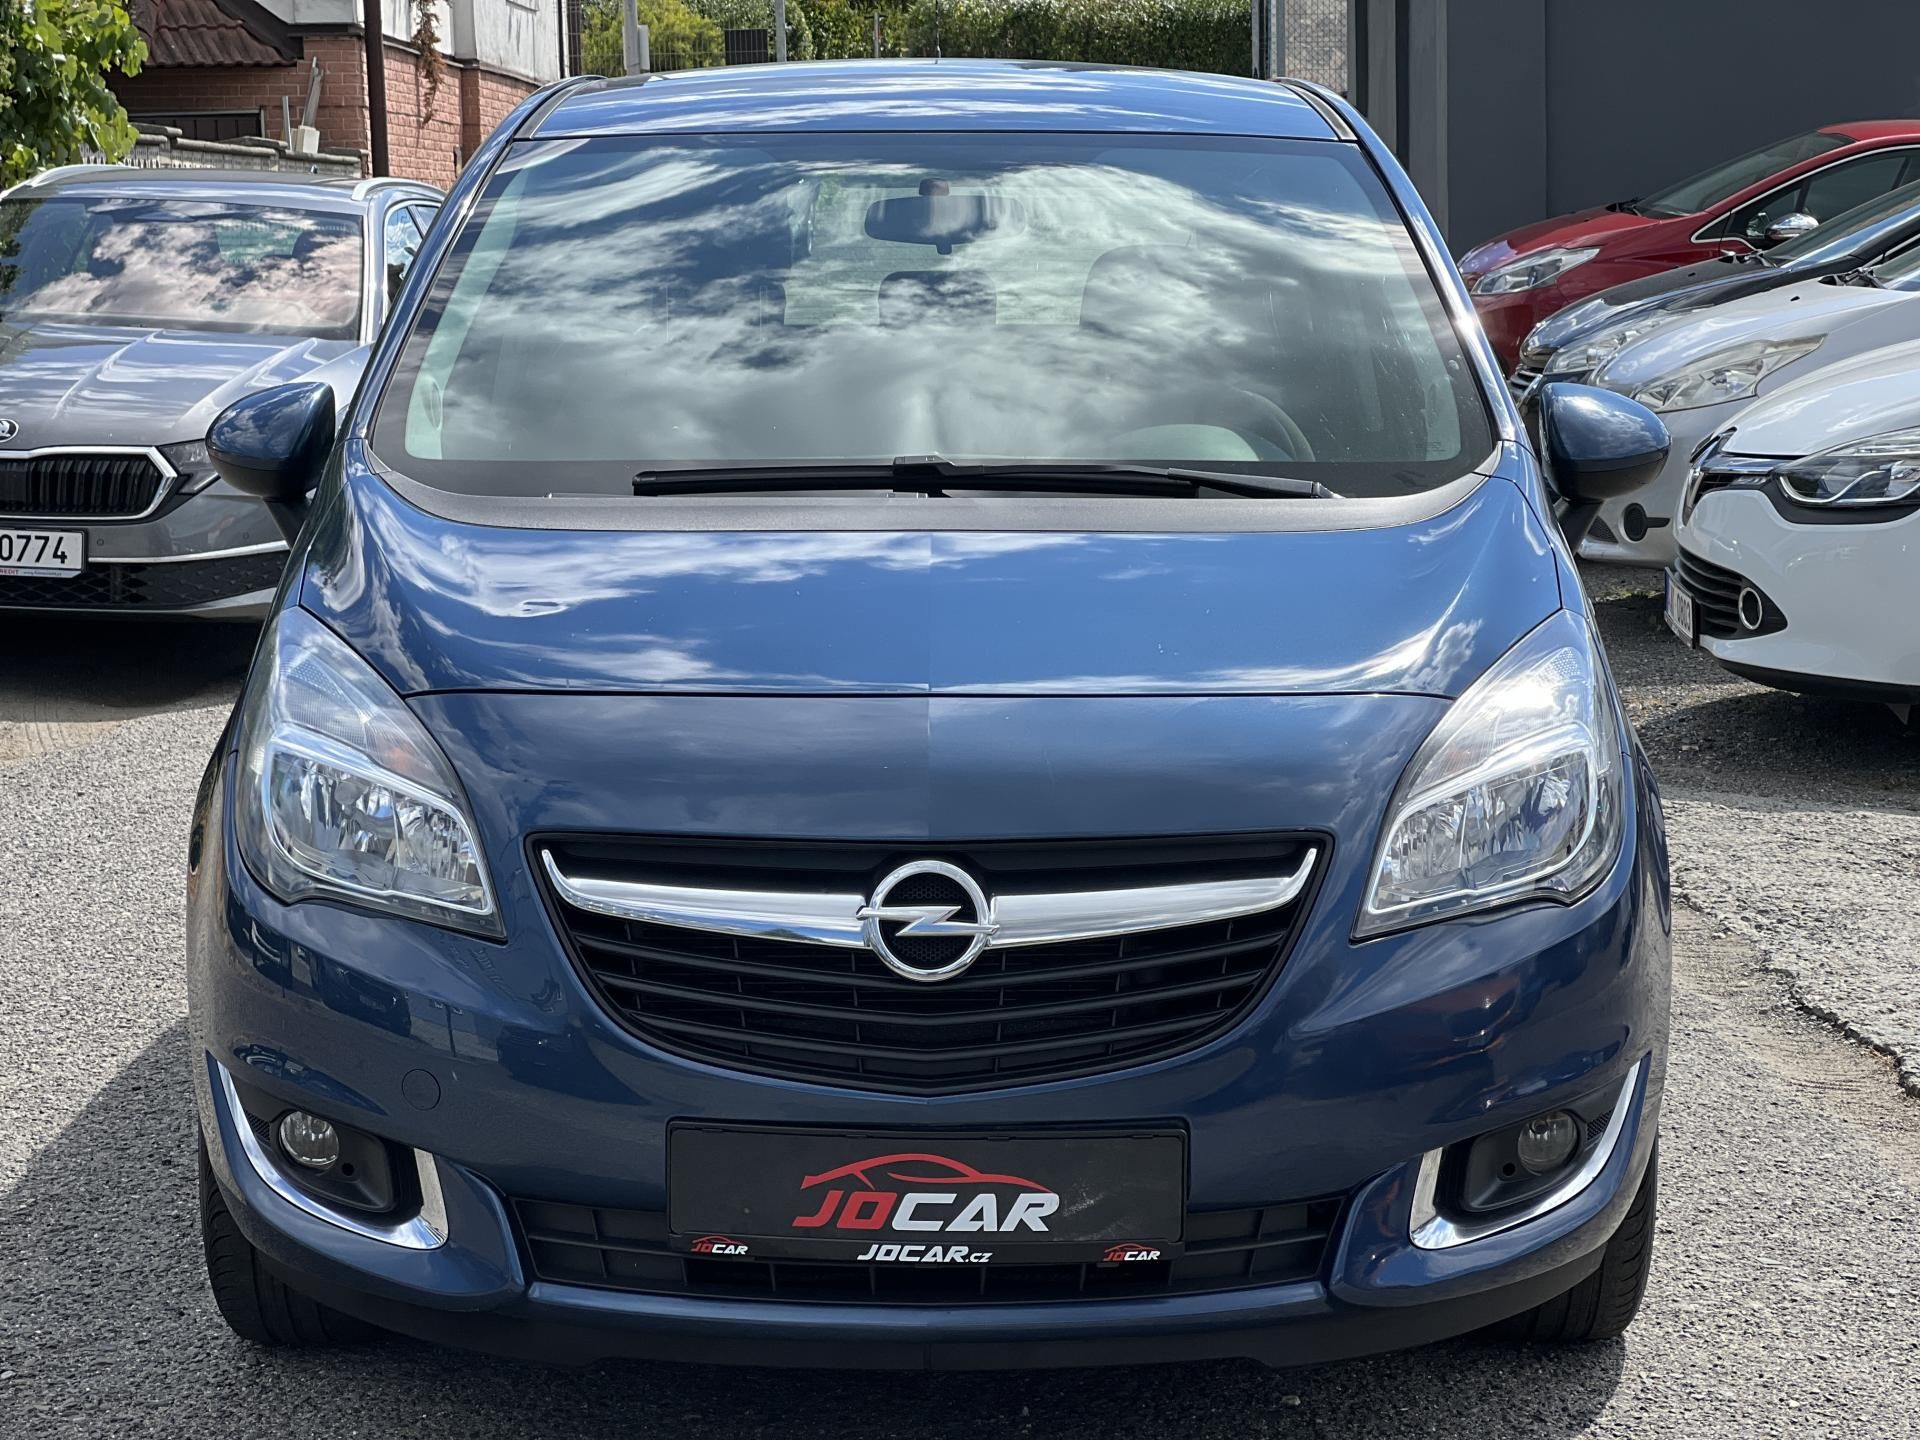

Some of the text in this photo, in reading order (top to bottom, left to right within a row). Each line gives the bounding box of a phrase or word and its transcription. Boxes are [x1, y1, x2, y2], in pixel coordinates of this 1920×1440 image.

[0, 534, 67, 564] 0774
[792, 1190, 1060, 1232] JOCAR
[691, 1243, 748, 1255] JOCAR
[1103, 1250, 1161, 1262] JOCAR
